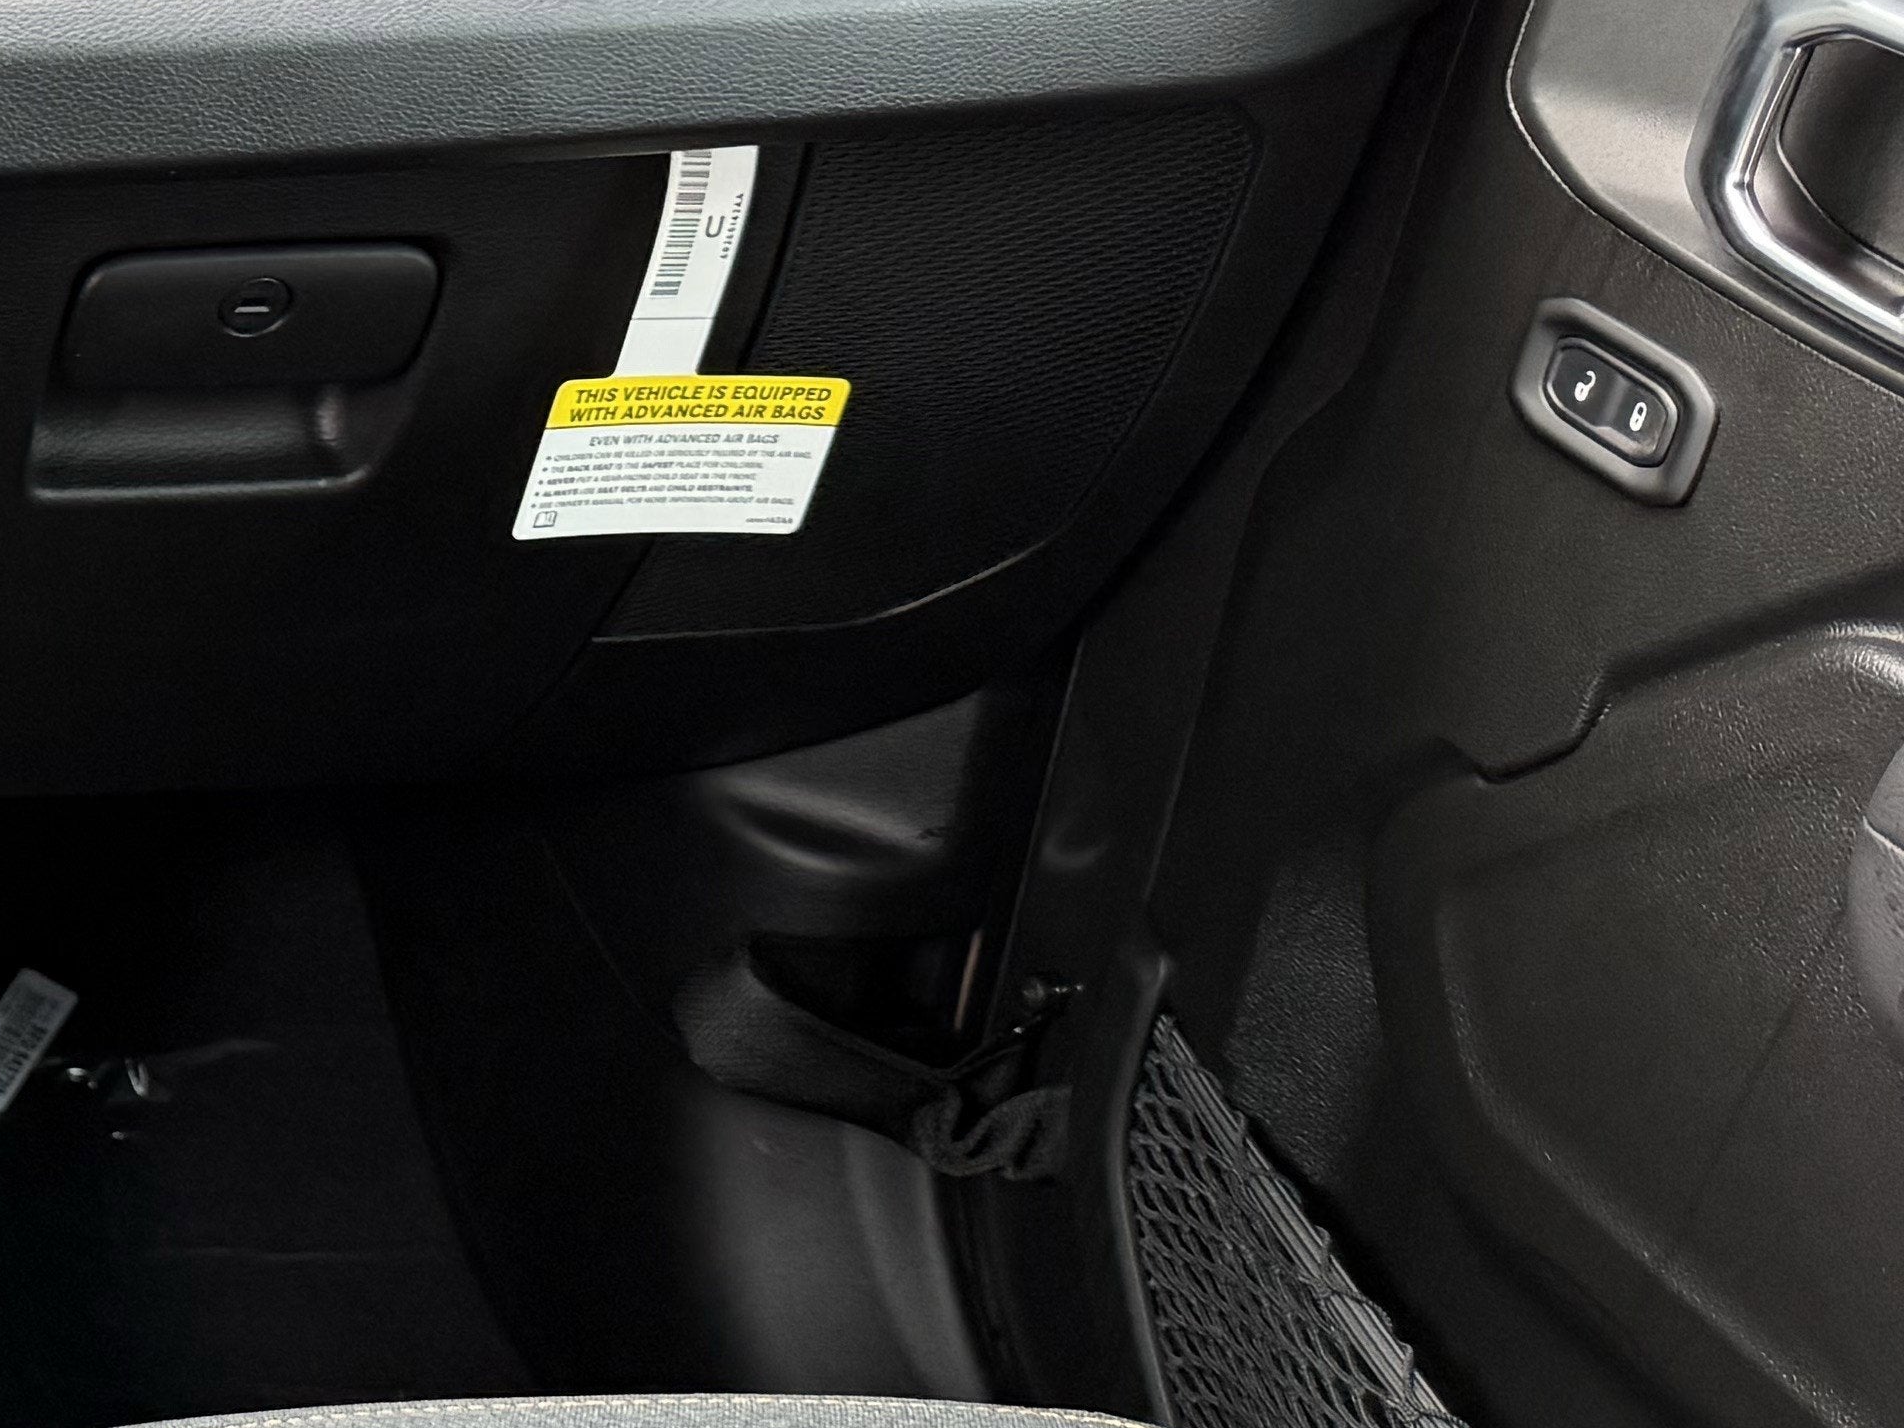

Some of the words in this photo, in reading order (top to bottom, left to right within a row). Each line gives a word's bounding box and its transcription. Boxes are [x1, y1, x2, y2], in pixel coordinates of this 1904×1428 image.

[574, 387, 619, 404] THIS
[622, 385, 704, 402] VEHICLE
[706, 385, 728, 401] IS
[730, 385, 832, 402] EQUIPPED
[569, 406, 617, 423] WITH
[620, 404, 729, 420] ADVANCED
[731, 404, 766, 419] AIR
[770, 405, 827, 420] BAGS
